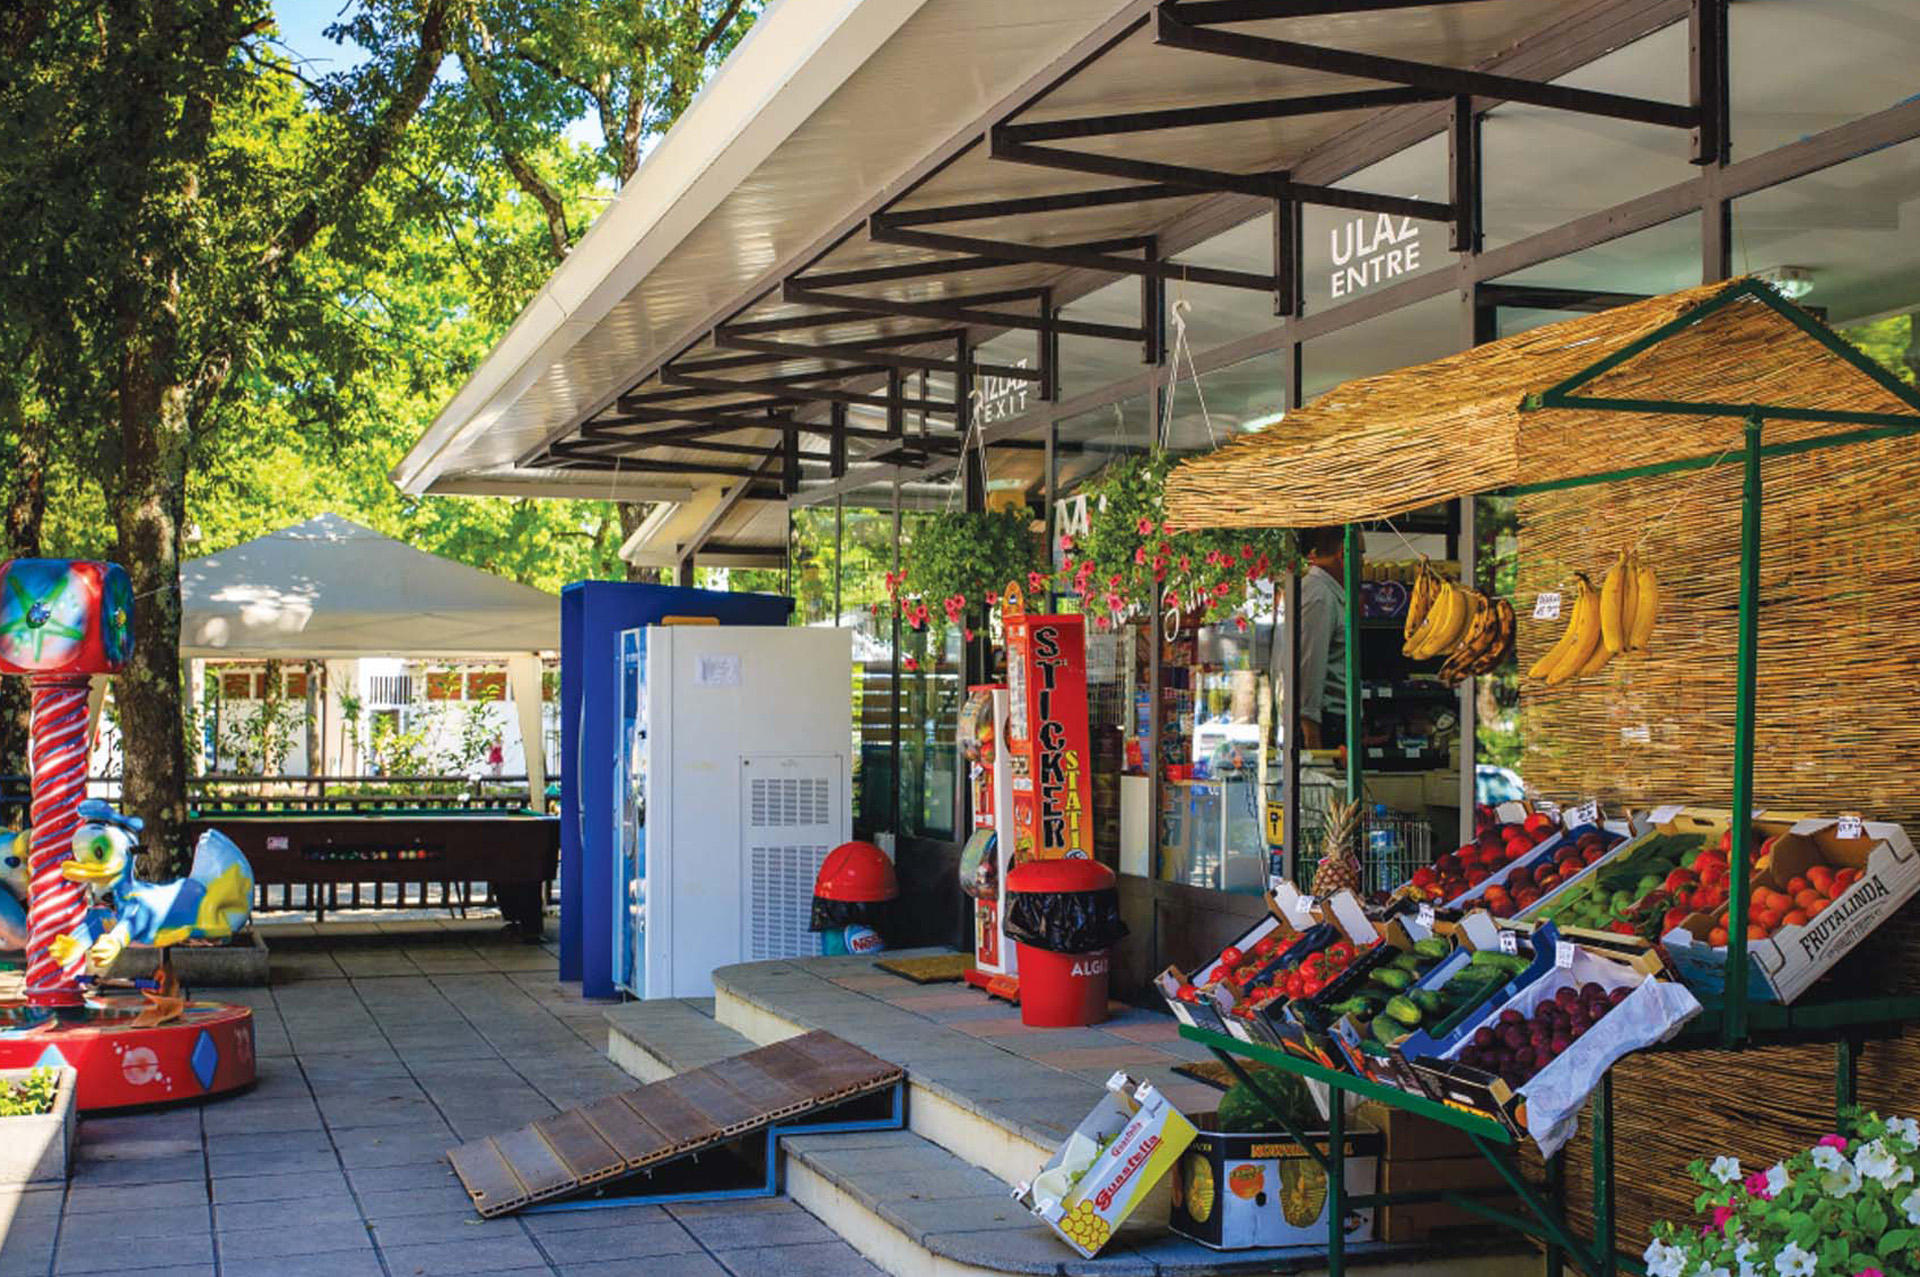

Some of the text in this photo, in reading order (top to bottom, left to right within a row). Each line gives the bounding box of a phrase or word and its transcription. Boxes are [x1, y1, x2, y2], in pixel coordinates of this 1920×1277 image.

[1331, 241, 1420, 299] ENTRE
[984, 391, 1028, 422] EXIT
[1034, 626, 1067, 849] STICKER
